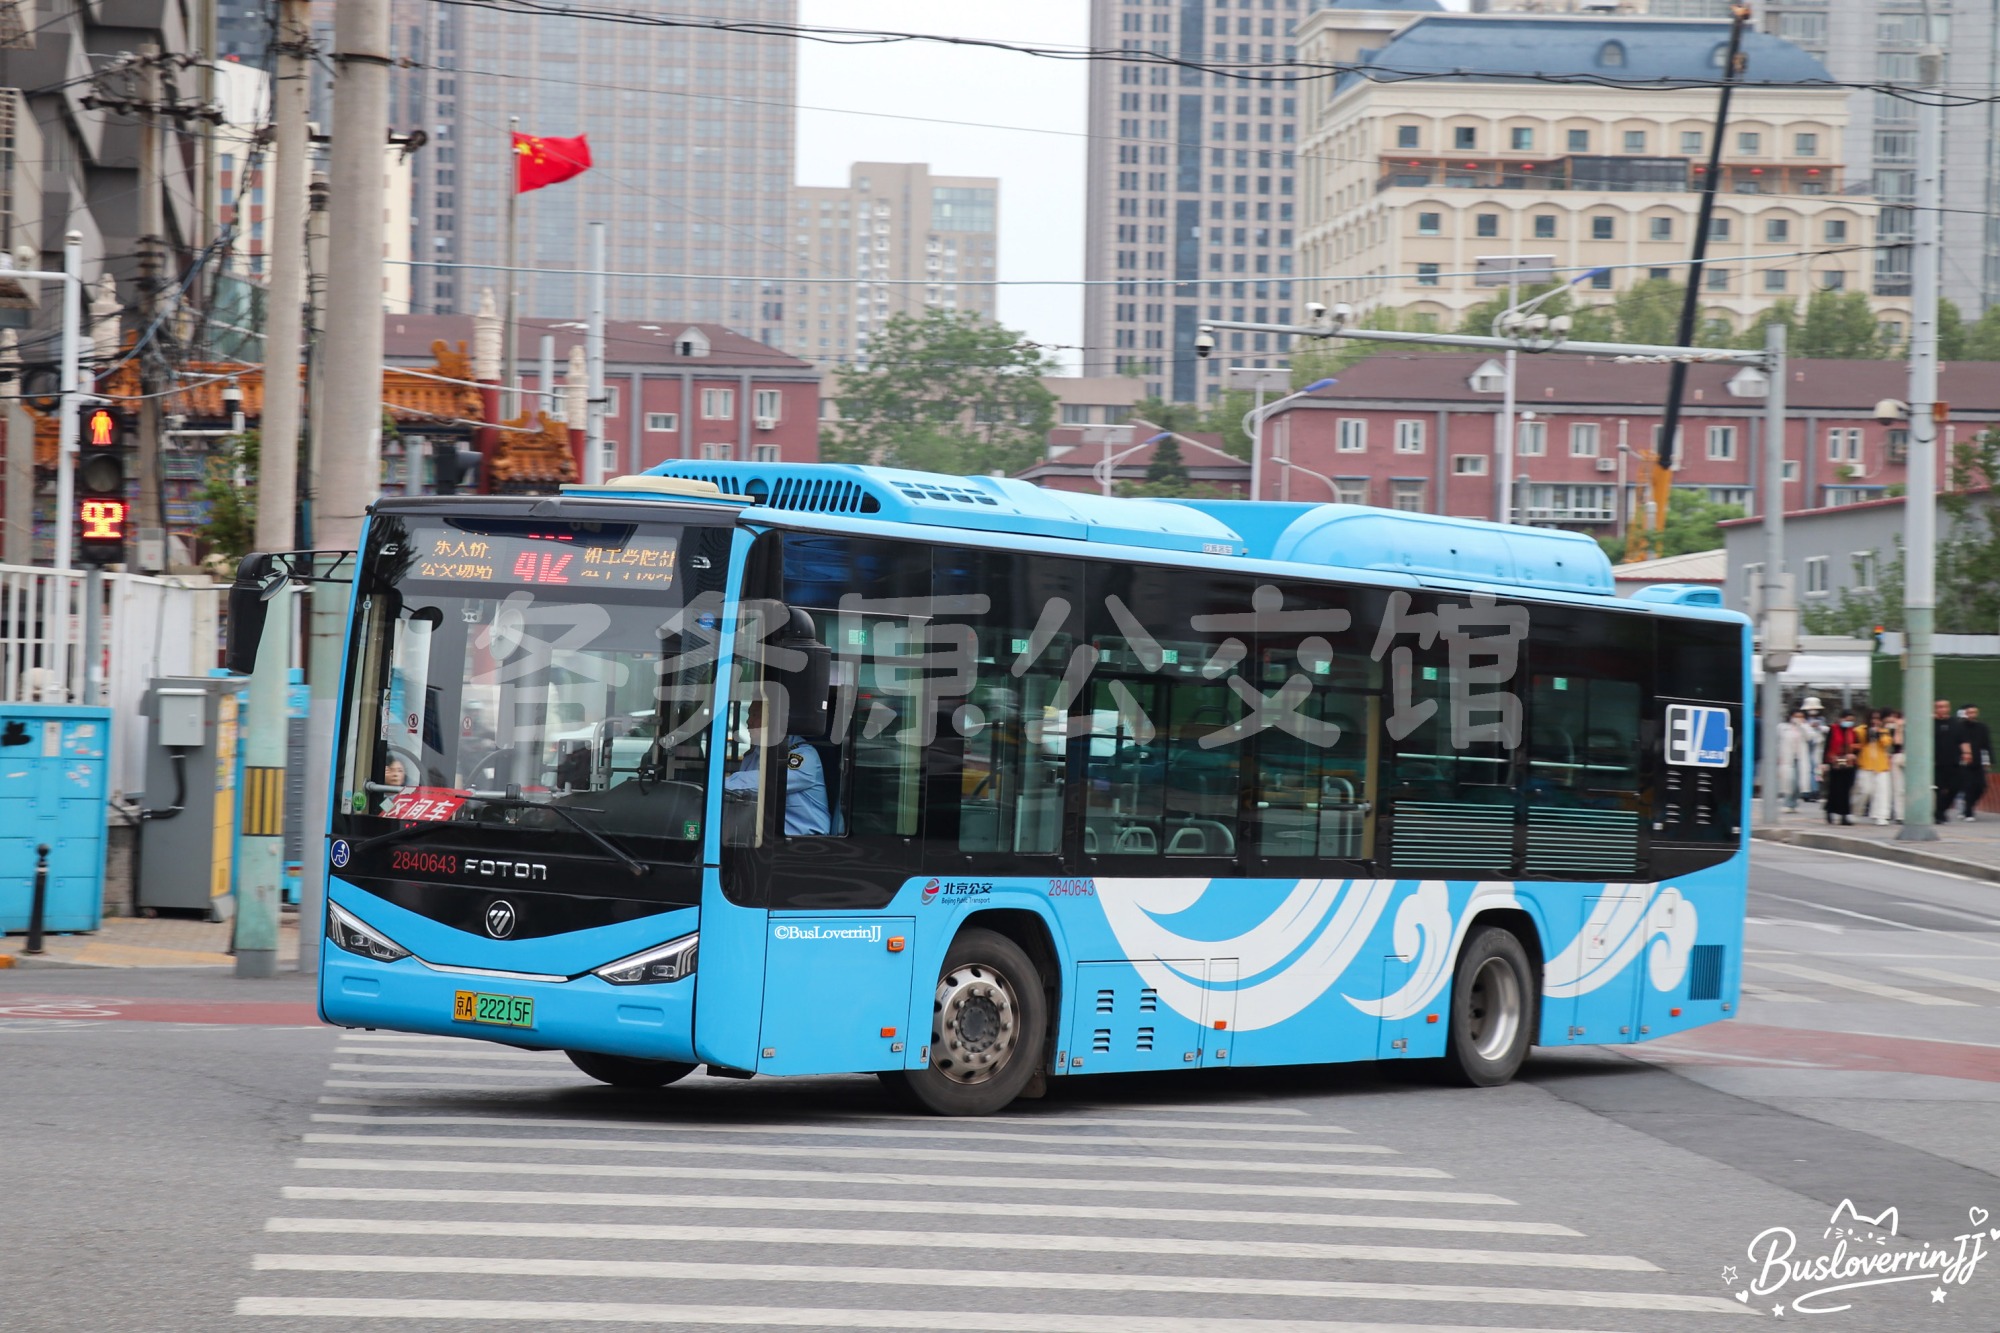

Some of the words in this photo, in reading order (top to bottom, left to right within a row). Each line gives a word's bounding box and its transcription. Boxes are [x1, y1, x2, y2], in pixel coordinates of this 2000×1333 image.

[382, 798, 455, 821] 区间车
[392, 850, 457, 875] 2840643
[463, 858, 548, 881] FOTON
[943, 882, 994, 895] 北京公交
[1048, 878, 1096, 898] 2840643
[941, 897, 957, 906] Beijing
[969, 897, 991, 905] Transport
